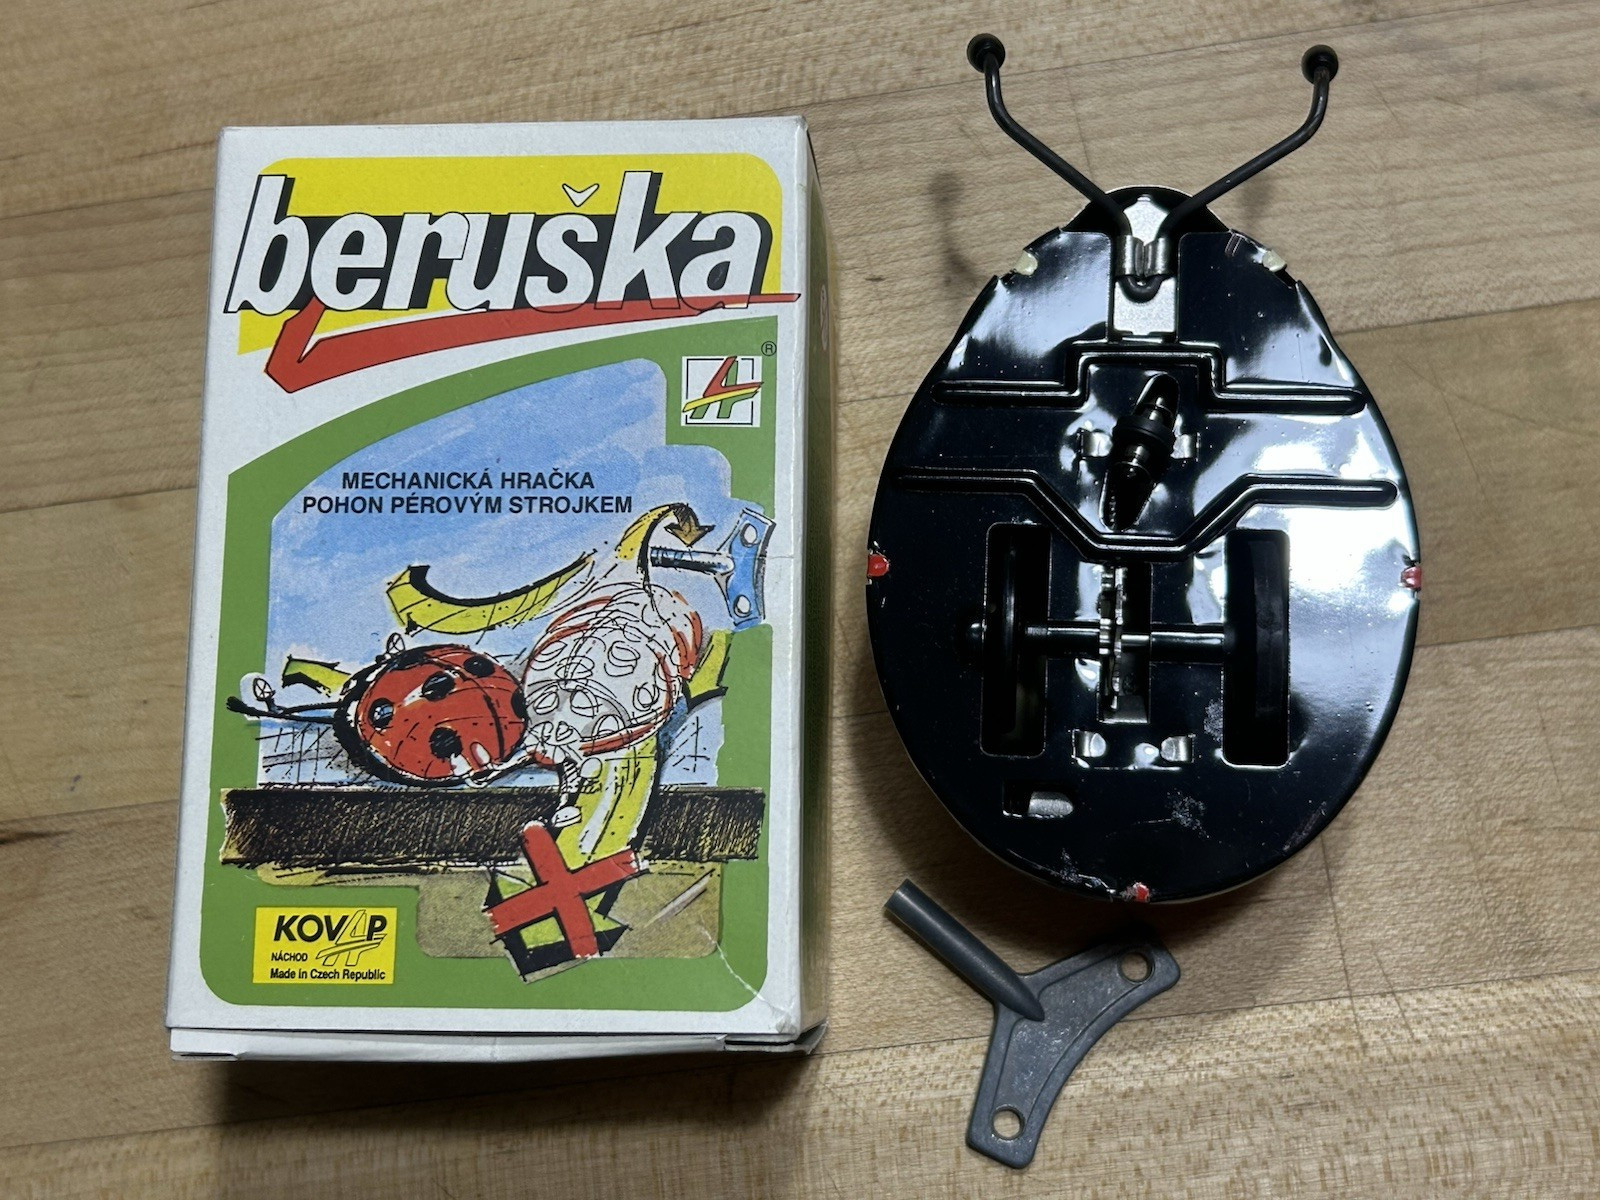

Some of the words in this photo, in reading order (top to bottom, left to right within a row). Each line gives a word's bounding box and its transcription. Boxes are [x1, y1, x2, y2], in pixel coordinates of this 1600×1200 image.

[224, 171, 773, 315] beruška
[342, 468, 492, 489] MECHANICKÁ
[501, 468, 595, 489] HRAČKA
[302, 496, 383, 514] POHON
[390, 492, 501, 514] PÉROVÝM
[508, 496, 633, 514] STROJKEM
[273, 910, 388, 966] KOVAP
[271, 950, 308, 962] NÁCHOD
[270, 968, 296, 979] Made
[298, 968, 307, 979] in
[310, 968, 340, 980] Czech
[342, 969, 386, 982] Republic
